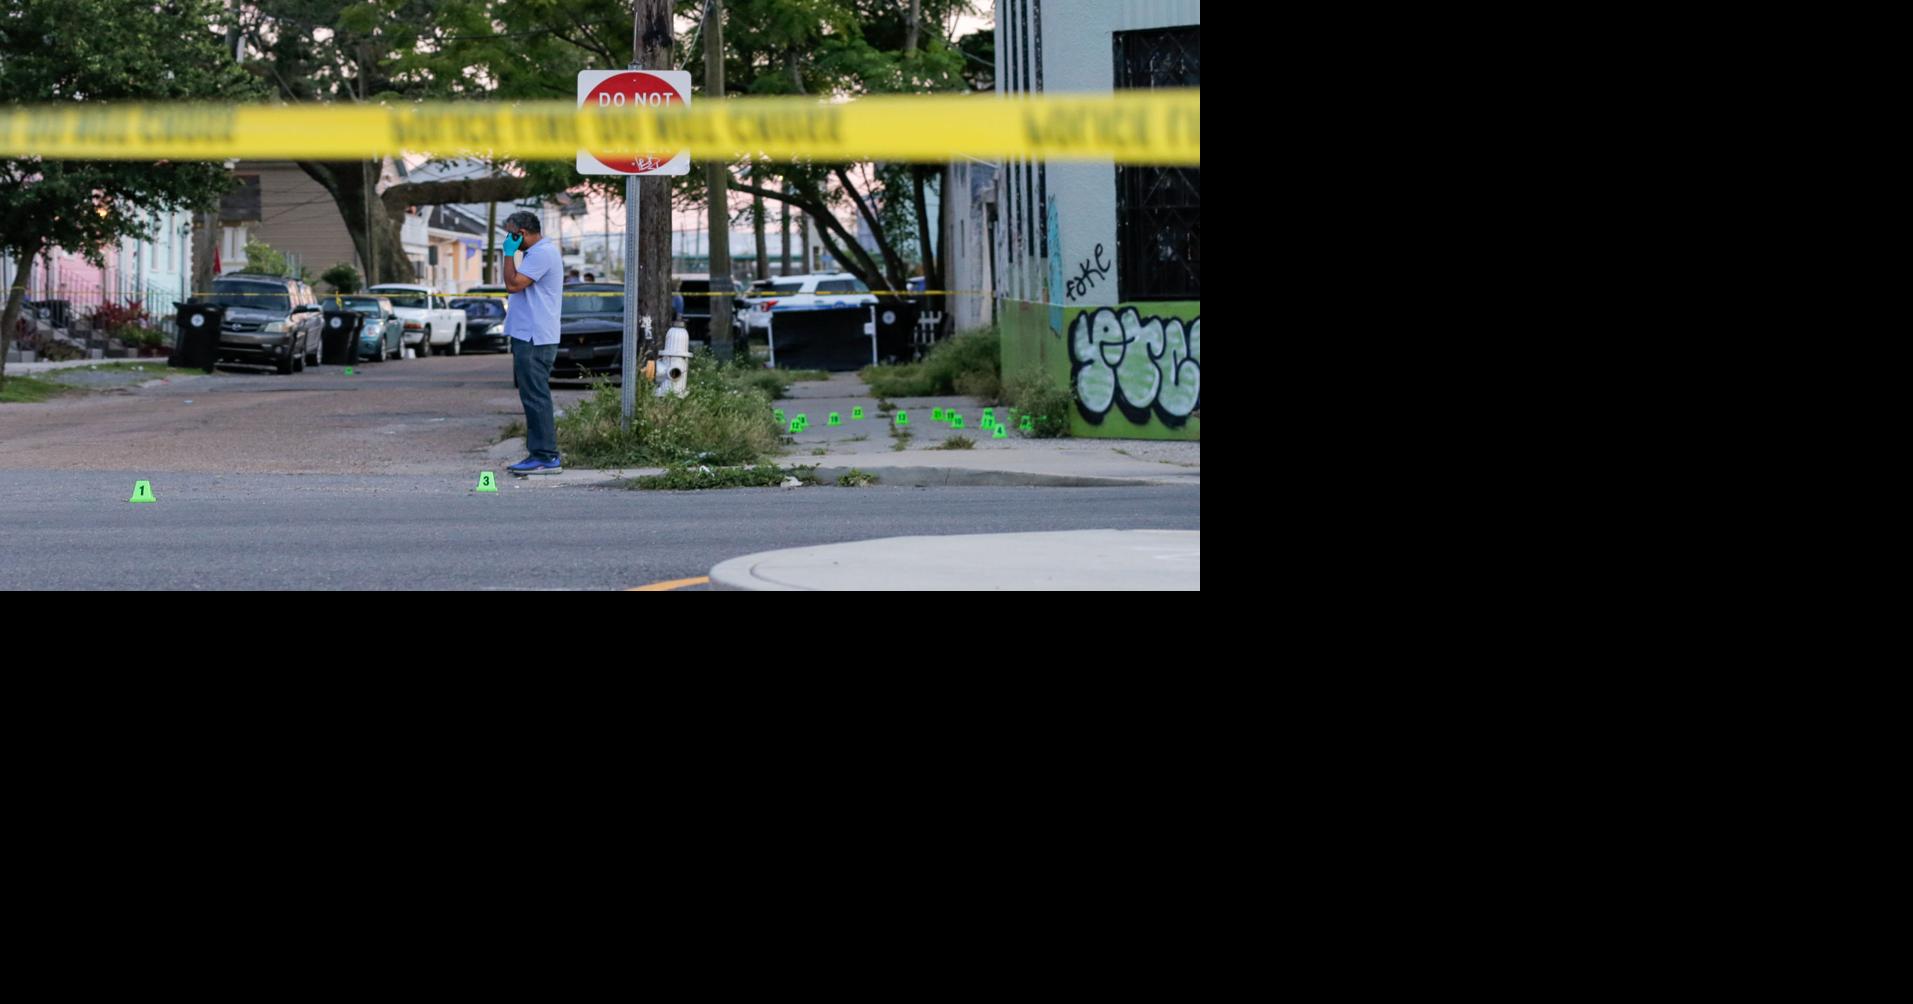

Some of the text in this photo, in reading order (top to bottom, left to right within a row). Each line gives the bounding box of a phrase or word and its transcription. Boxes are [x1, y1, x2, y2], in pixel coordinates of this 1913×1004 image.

[599, 92, 673, 108] DO NOT
[483, 476, 490, 486] 3
[139, 485, 145, 496] 1
